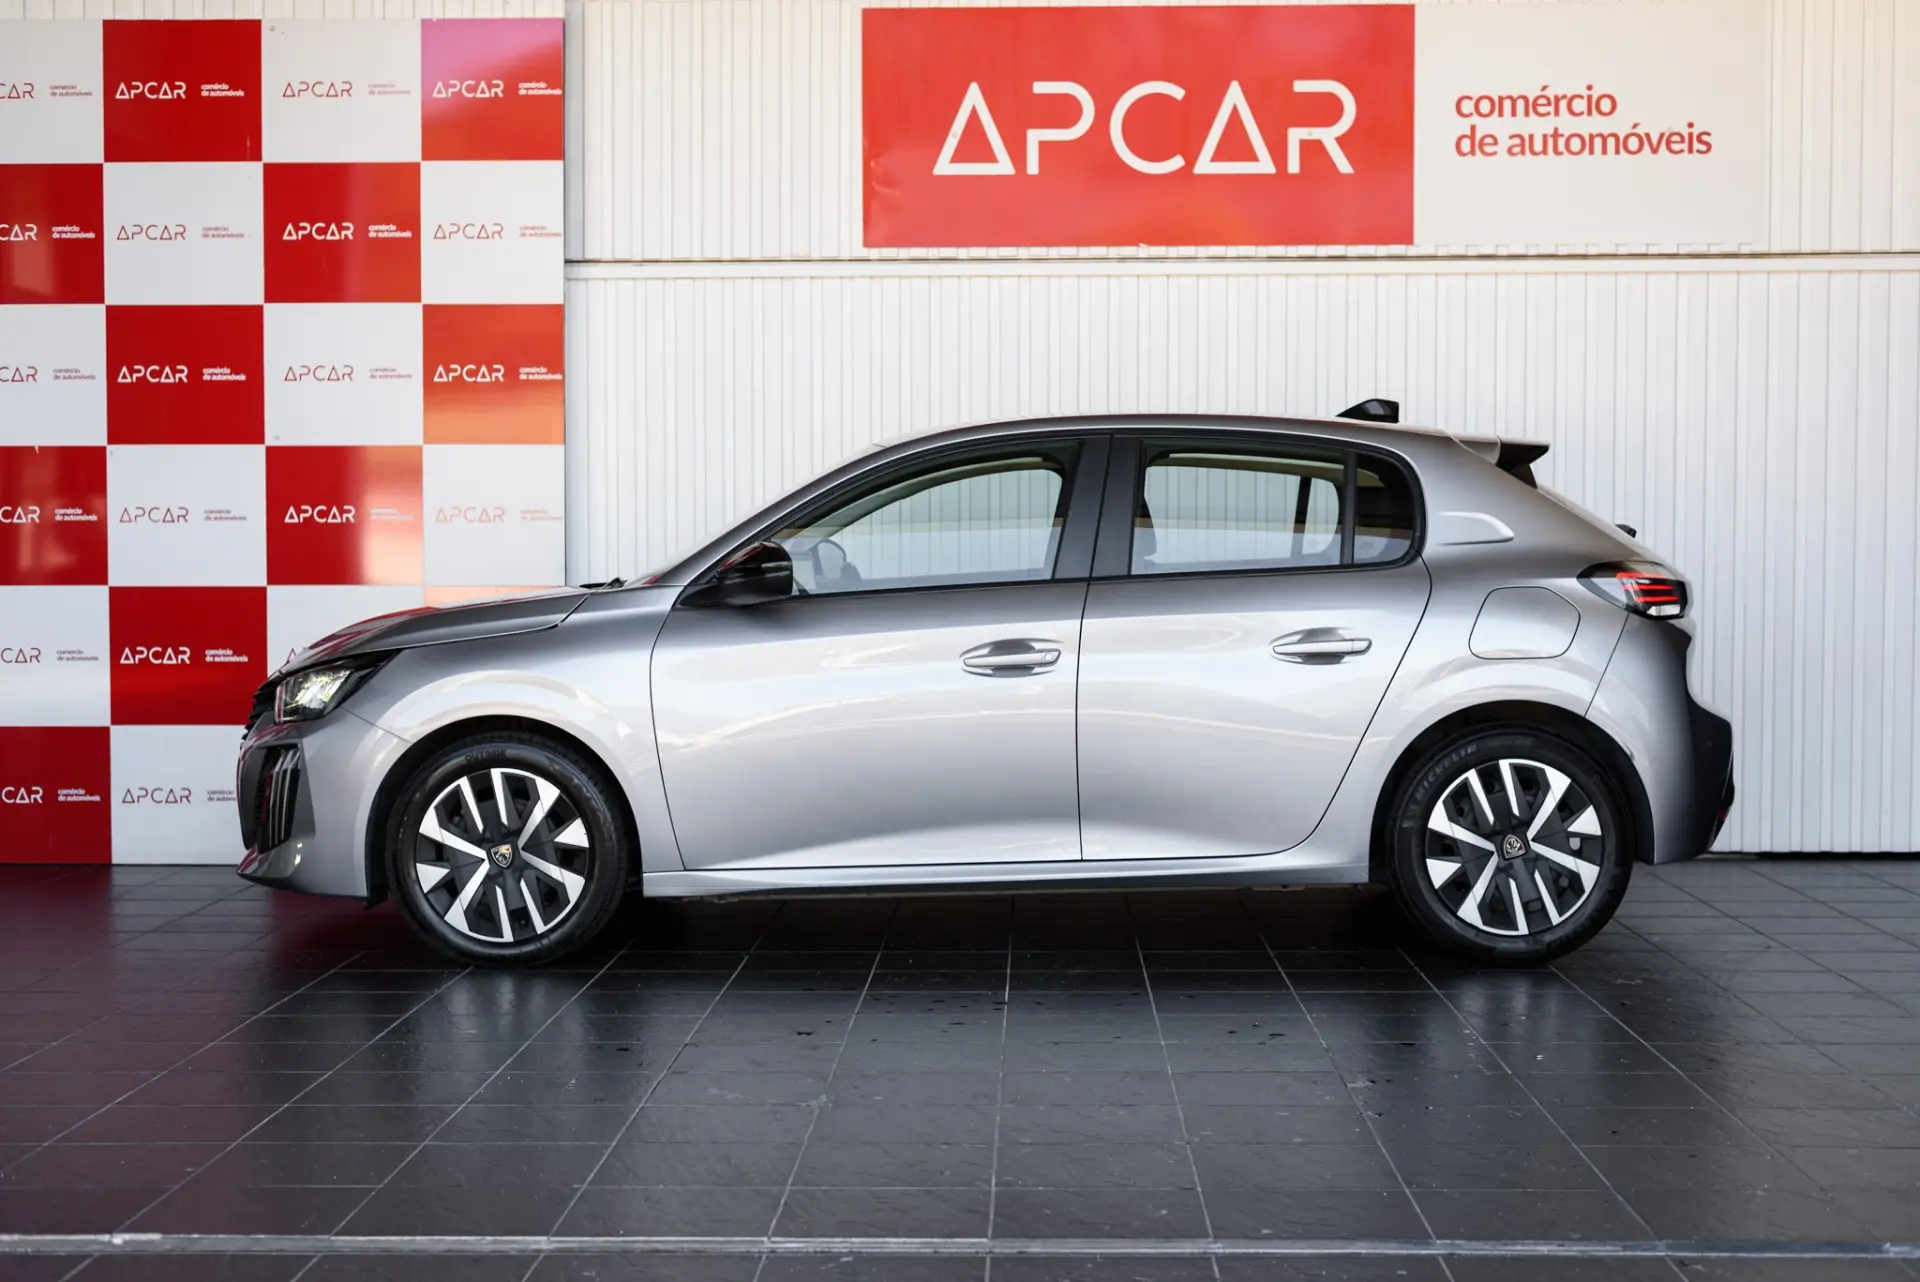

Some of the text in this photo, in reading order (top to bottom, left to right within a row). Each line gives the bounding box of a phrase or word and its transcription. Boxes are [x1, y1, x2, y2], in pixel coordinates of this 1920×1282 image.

[116, 82, 186, 99] APCAR
[283, 81, 352, 97] APCAR
[432, 80, 504, 98] APCAR
[1455, 84, 1617, 119] comércio
[933, 80, 1356, 176] APCAR
[1455, 120, 1713, 157] de automóveis
[117, 224, 186, 240] APCAR
[283, 222, 354, 240] APCAR
[433, 223, 503, 239] APCAR
[118, 365, 188, 383] APCAR
[284, 365, 353, 381] APCAR
[434, 365, 504, 382] APCAR
[0, 505, 40, 524] CAR
[120, 507, 189, 523] APCAR
[285, 506, 355, 523] APCAR
[1, 648, 41, 663] CAR
[120, 647, 190, 664] APCAR
[2, 787, 43, 803] CAR
[122, 787, 191, 804] APCAR
